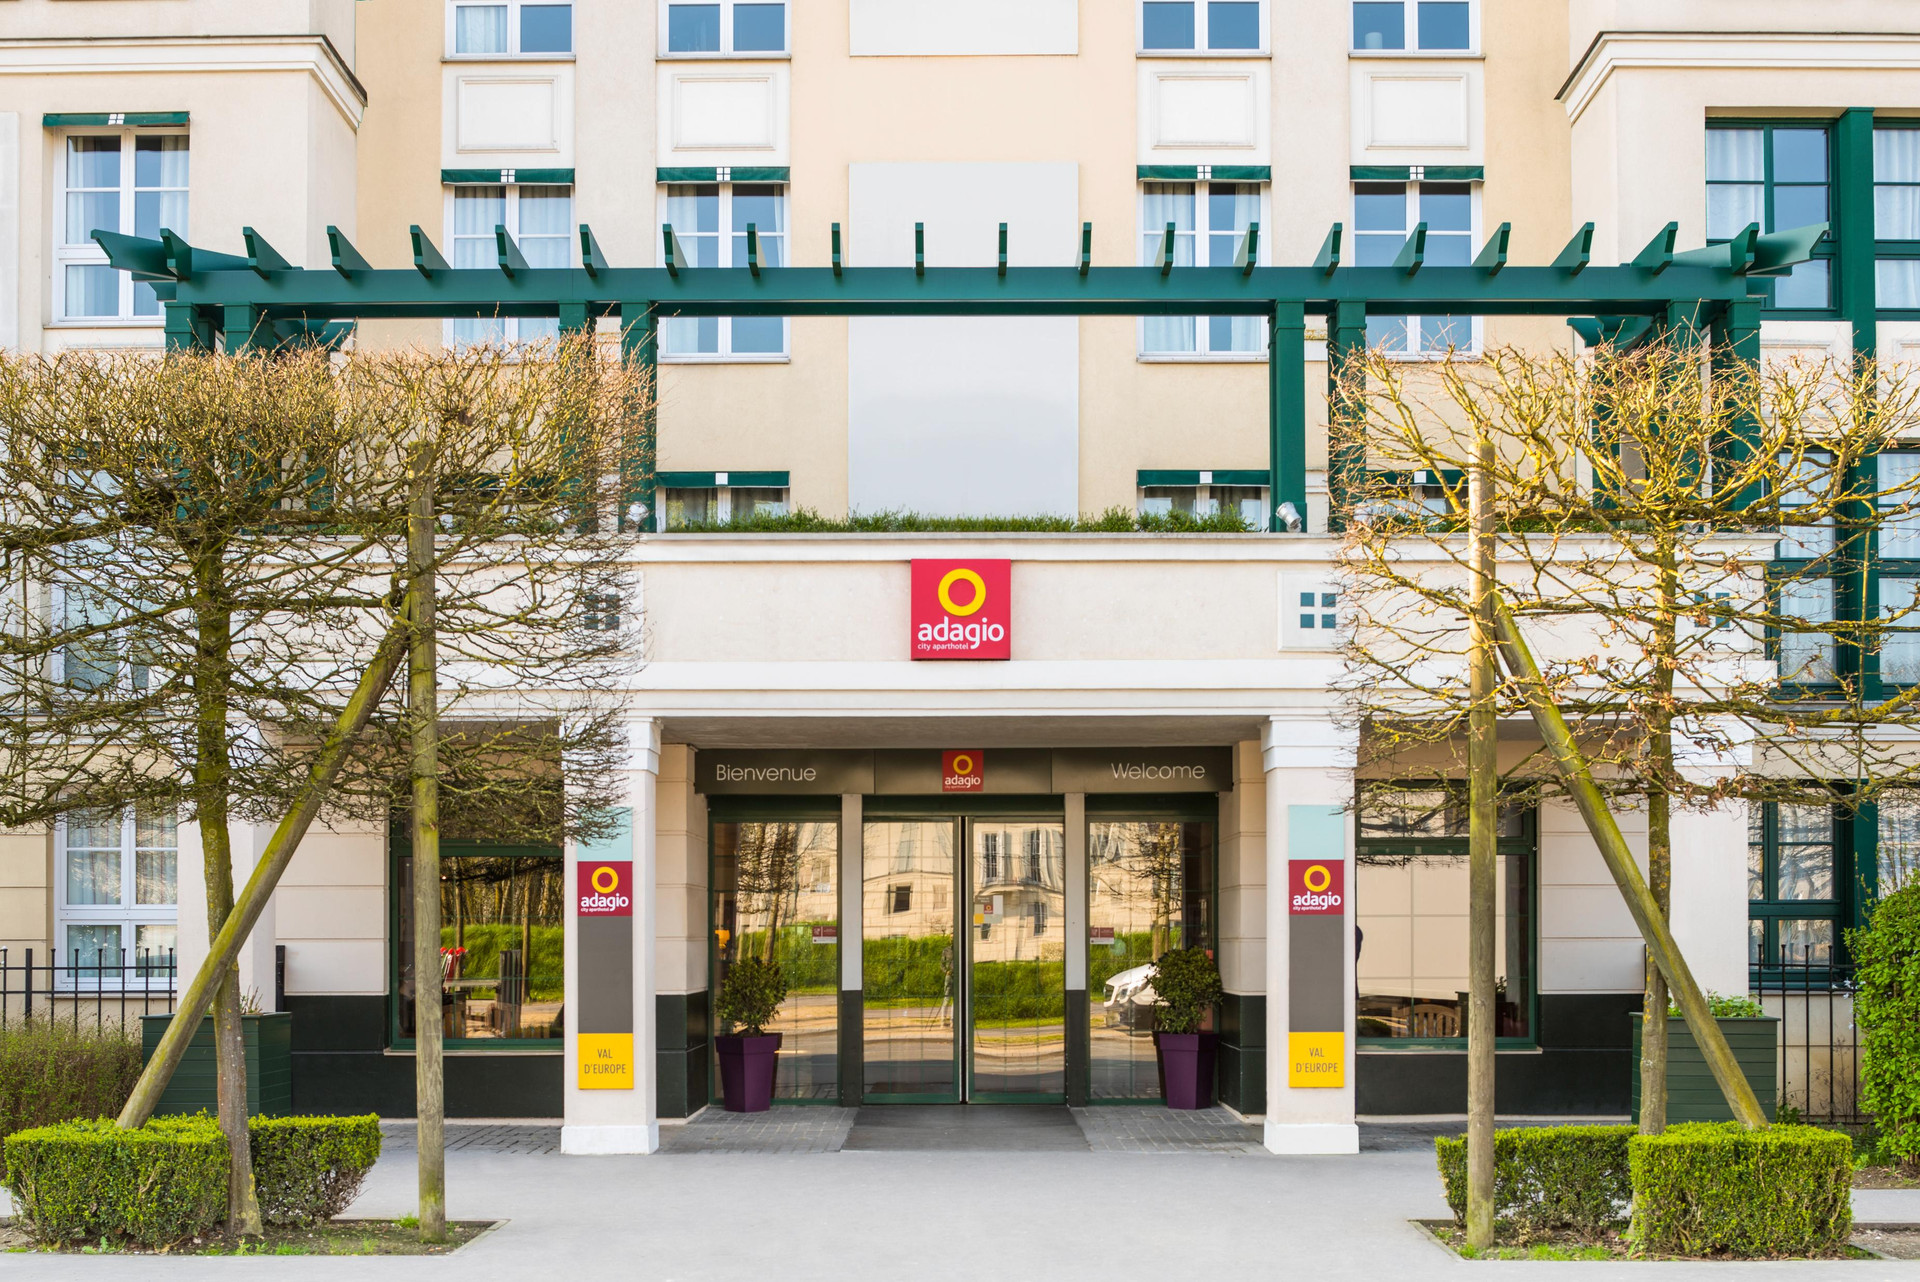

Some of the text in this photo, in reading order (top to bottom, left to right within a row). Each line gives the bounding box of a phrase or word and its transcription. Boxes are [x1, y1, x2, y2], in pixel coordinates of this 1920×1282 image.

[917, 616, 1005, 650] adagio
[917, 642, 969, 651] city aparthotel
[716, 764, 817, 781] Bienvenue
[1111, 762, 1205, 780] Welcome
[944, 774, 981, 789] adagio
[580, 892, 629, 912] adagio
[1292, 890, 1342, 910] adagio
[597, 1048, 613, 1059] VAL
[1309, 1047, 1325, 1058] VAL
[584, 1063, 626, 1074] D'EUROPE
[1295, 1062, 1338, 1073] D'EUROPE
